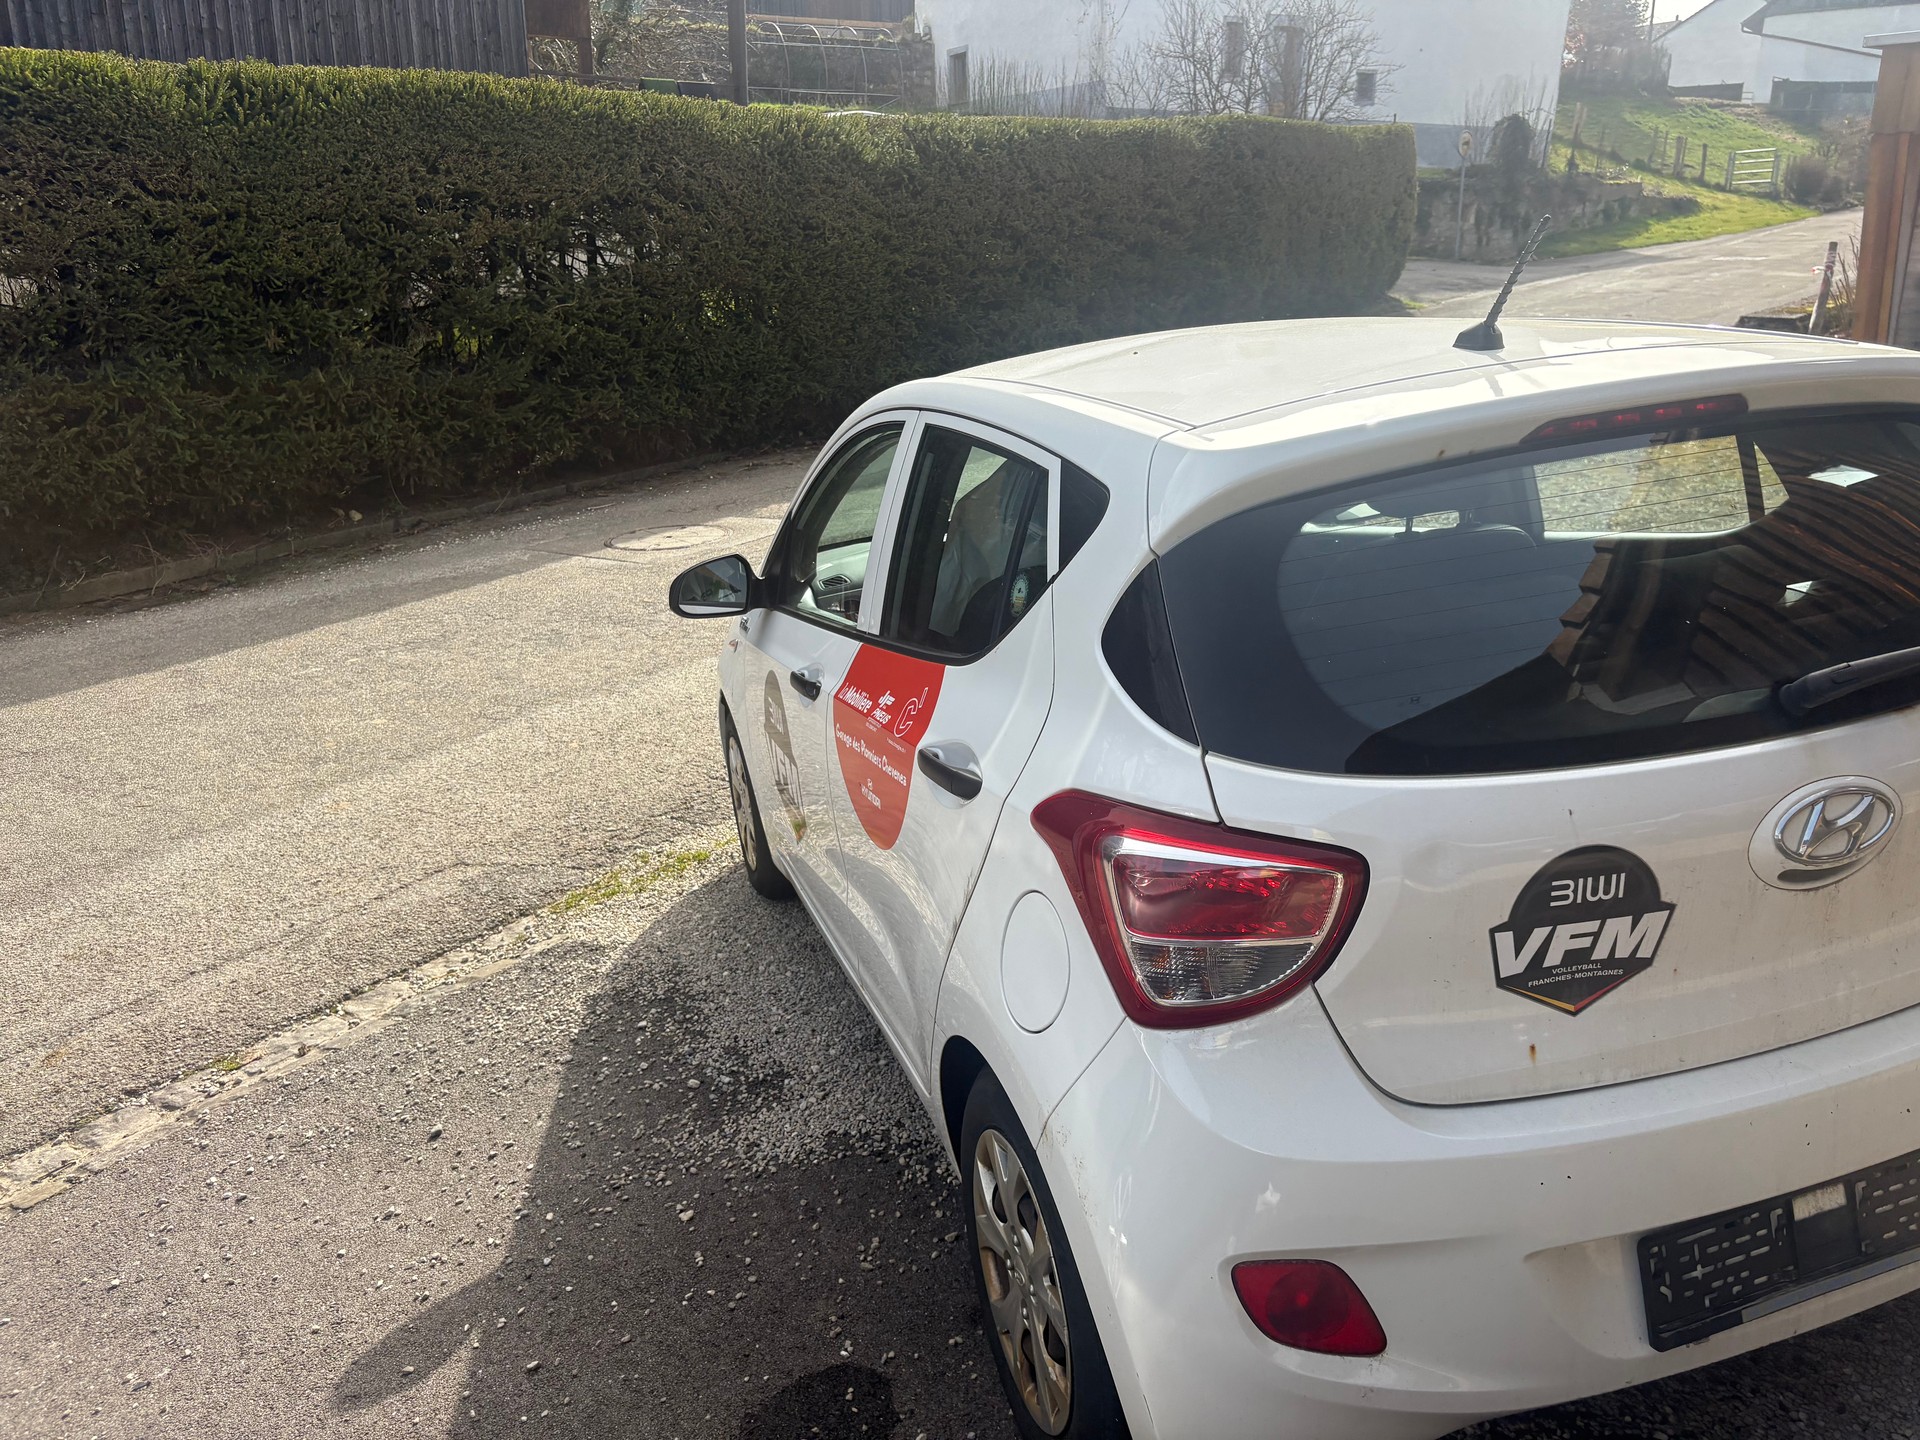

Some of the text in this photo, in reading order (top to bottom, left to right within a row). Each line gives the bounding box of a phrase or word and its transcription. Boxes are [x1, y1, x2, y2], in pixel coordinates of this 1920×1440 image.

[870, 707, 892, 725] PNEUS
[835, 723, 852, 747] Garage
[852, 736, 861, 752] des
[1549, 872, 1626, 907] BIWI
[1494, 909, 1670, 979] VFM
[1551, 962, 1602, 974] VOLLEYBALL
